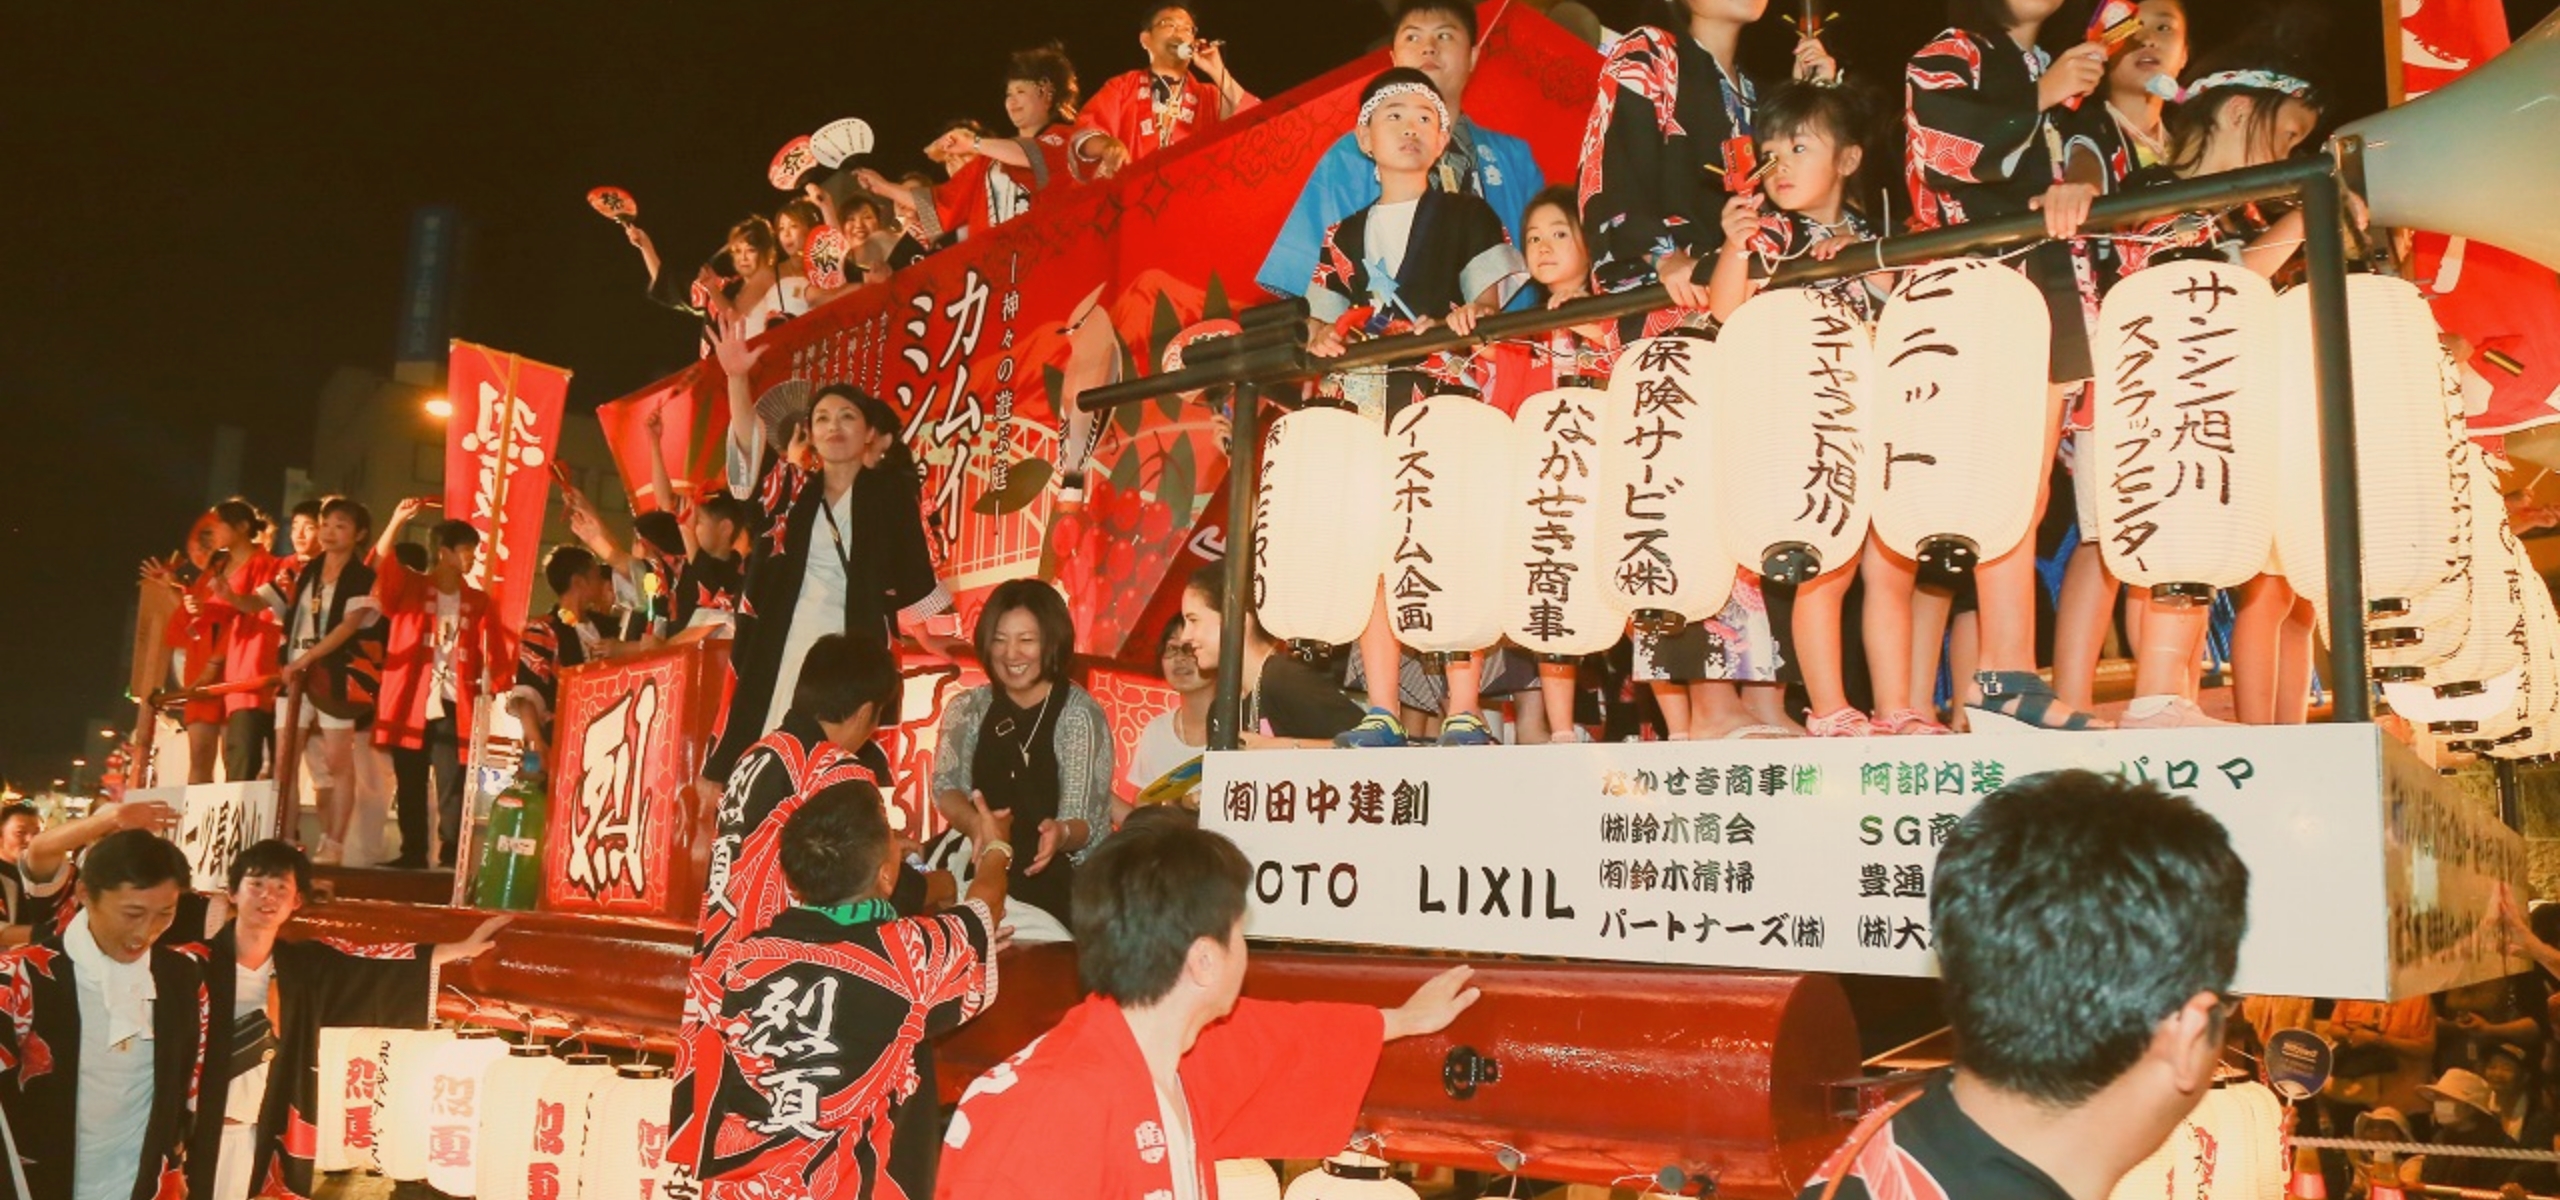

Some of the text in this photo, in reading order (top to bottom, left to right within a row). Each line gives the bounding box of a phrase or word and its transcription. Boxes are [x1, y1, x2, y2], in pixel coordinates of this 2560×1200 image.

[939, 270, 989, 541] カムイ
[2165, 270, 2240, 506] サンシン旭川
[1393, 405, 1443, 634] ノースホーム企画
[1522, 398, 1597, 642] なかせき商事
[568, 681, 659, 895] 烈
[1859, 760, 2005, 796] 阿部内装
[1256, 860, 1575, 920] OTO LIXIL
[1857, 914, 1934, 951] (株)大
[741, 976, 841, 1141] 烈夏
